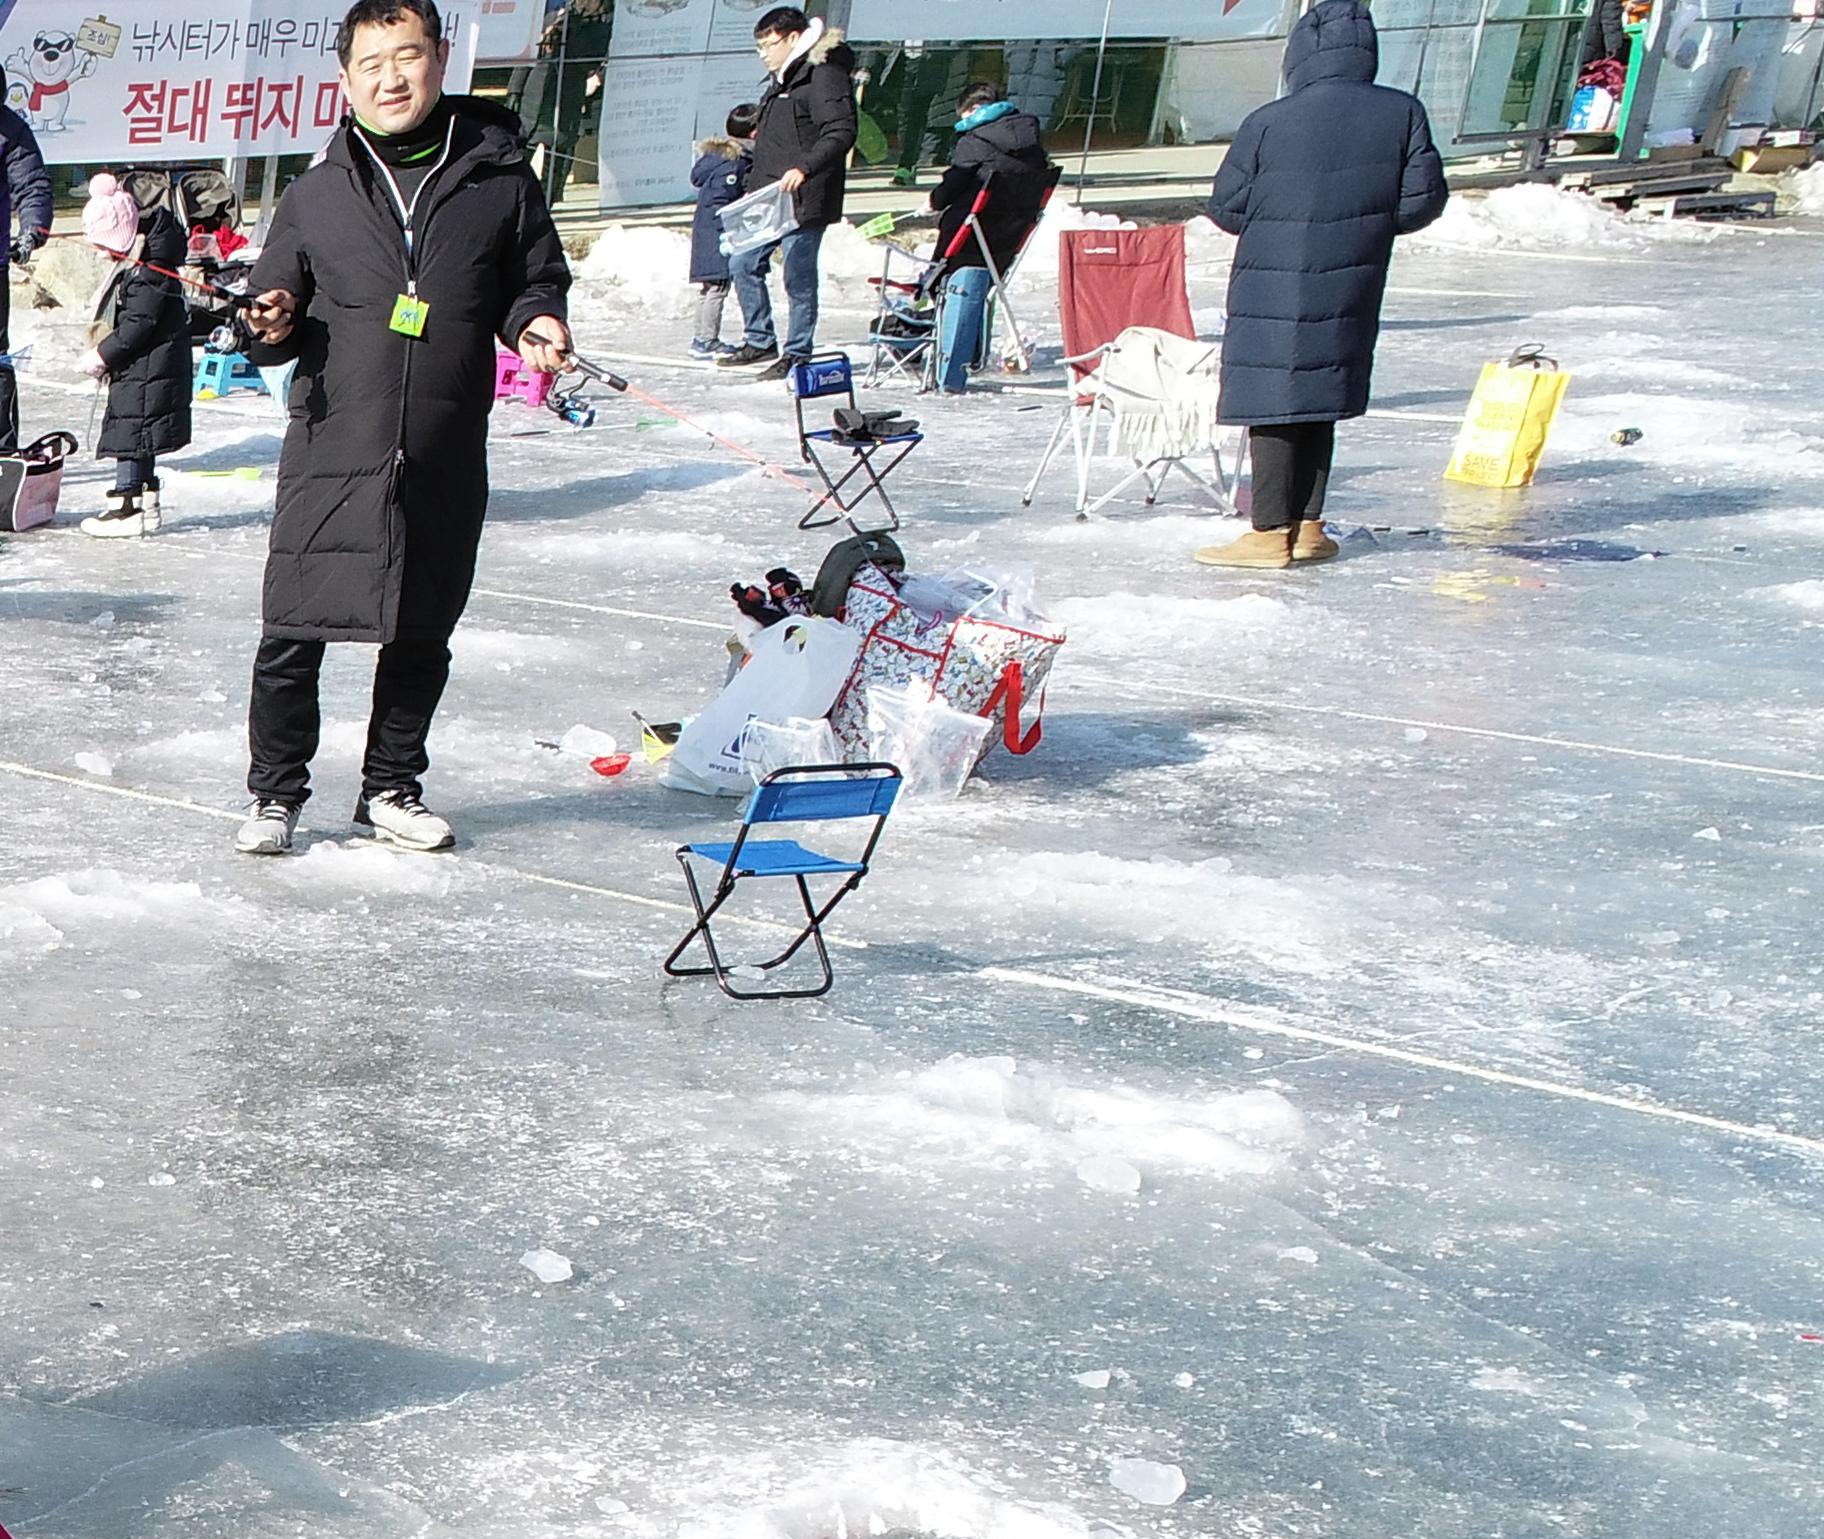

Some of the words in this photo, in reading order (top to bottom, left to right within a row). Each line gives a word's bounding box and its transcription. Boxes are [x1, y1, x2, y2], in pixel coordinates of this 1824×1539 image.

[132, 19, 240, 62] 낚시터가
[246, 17, 298, 59] 매우
[122, 78, 213, 145] 절대
[220, 75, 304, 141] 뛰지
